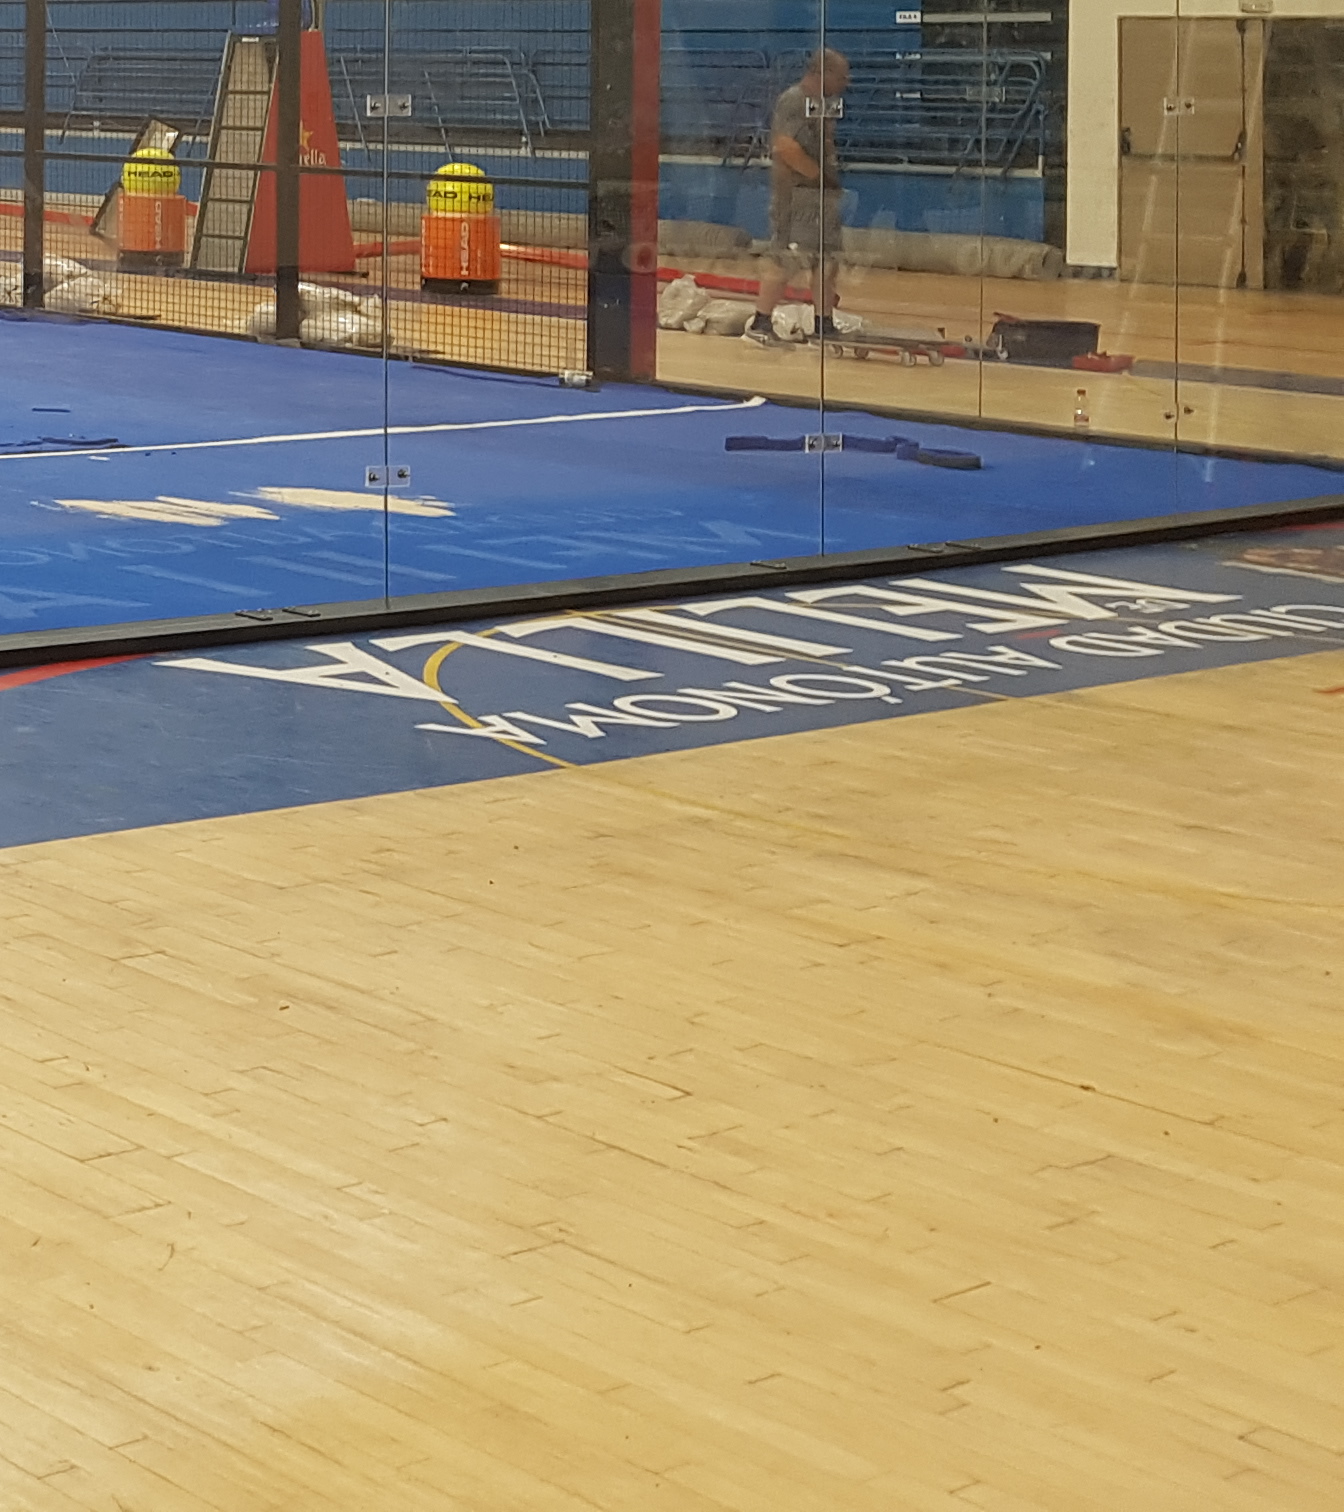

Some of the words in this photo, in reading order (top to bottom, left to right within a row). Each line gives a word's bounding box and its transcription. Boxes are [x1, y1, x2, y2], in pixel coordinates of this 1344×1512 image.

[127, 169, 174, 178] HEAD
[460, 221, 469, 276] HEAD
[152, 562, 1245, 704] MELILLA
[415, 644, 1064, 746] AUTÓNOMA
